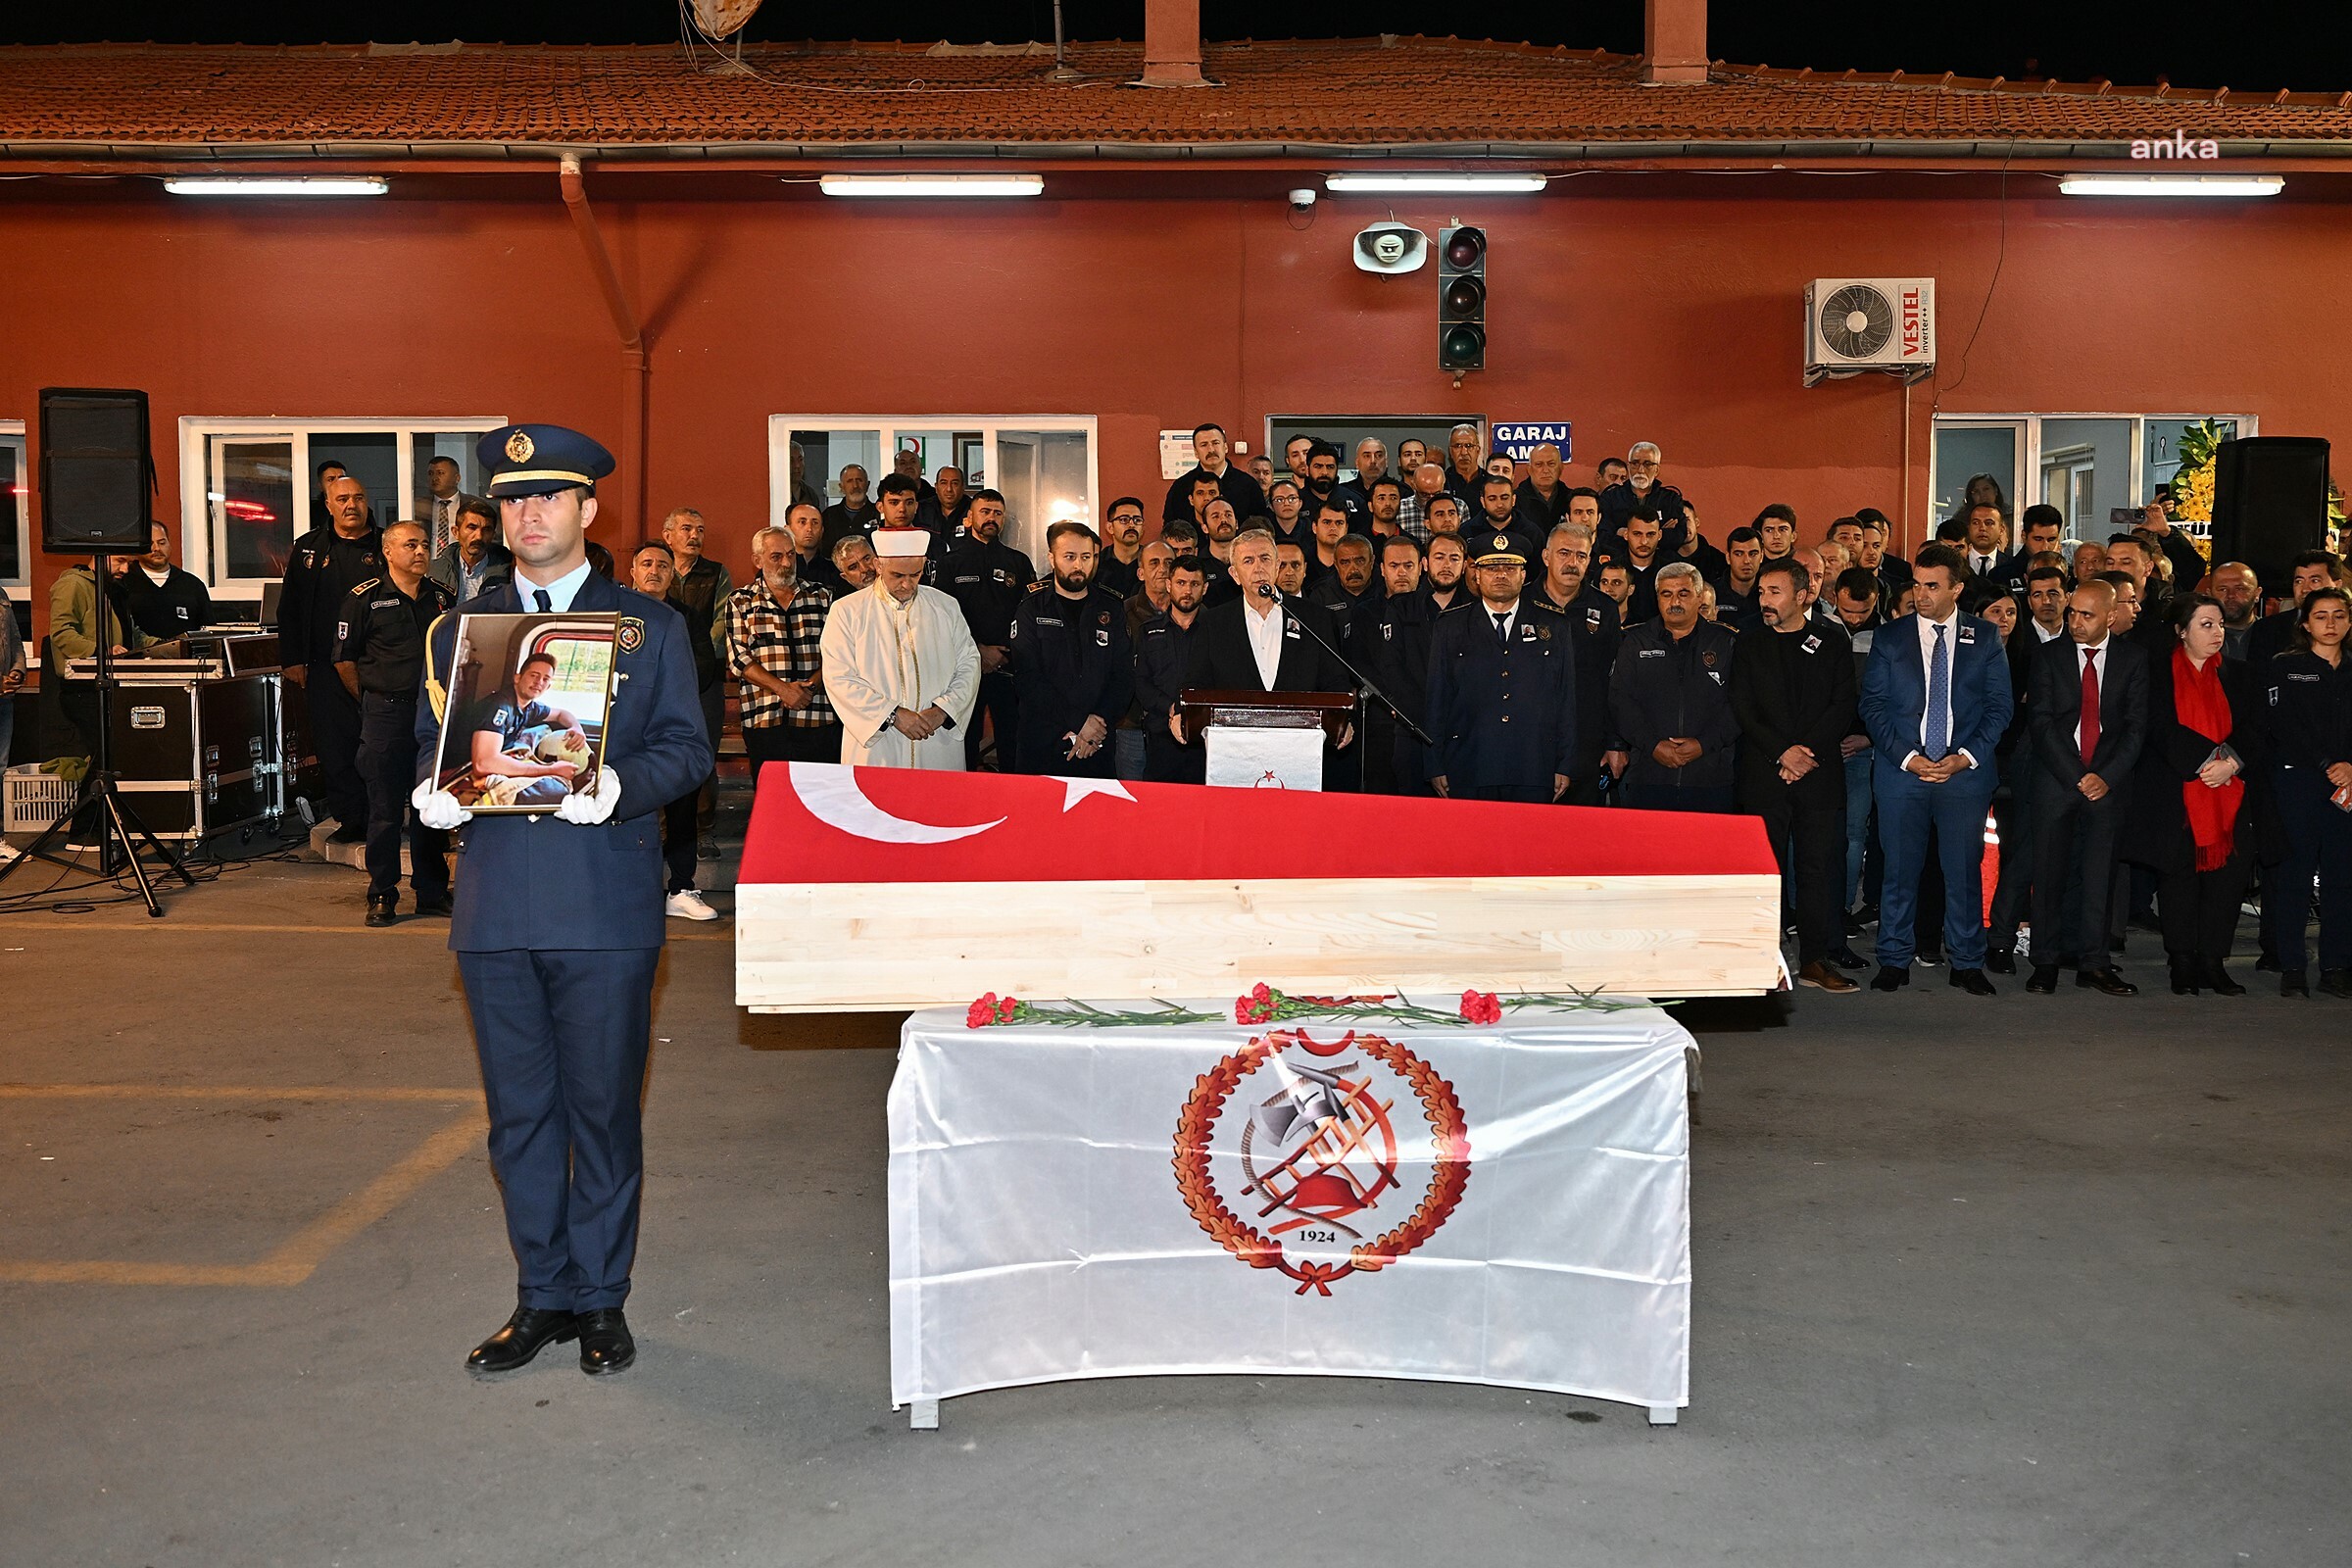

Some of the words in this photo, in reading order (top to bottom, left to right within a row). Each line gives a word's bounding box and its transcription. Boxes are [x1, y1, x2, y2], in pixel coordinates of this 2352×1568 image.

[1903, 287, 1919, 357] VESTEL
[1496, 426, 1567, 441] GARAJ
[1299, 1230, 1336, 1244] 1924
